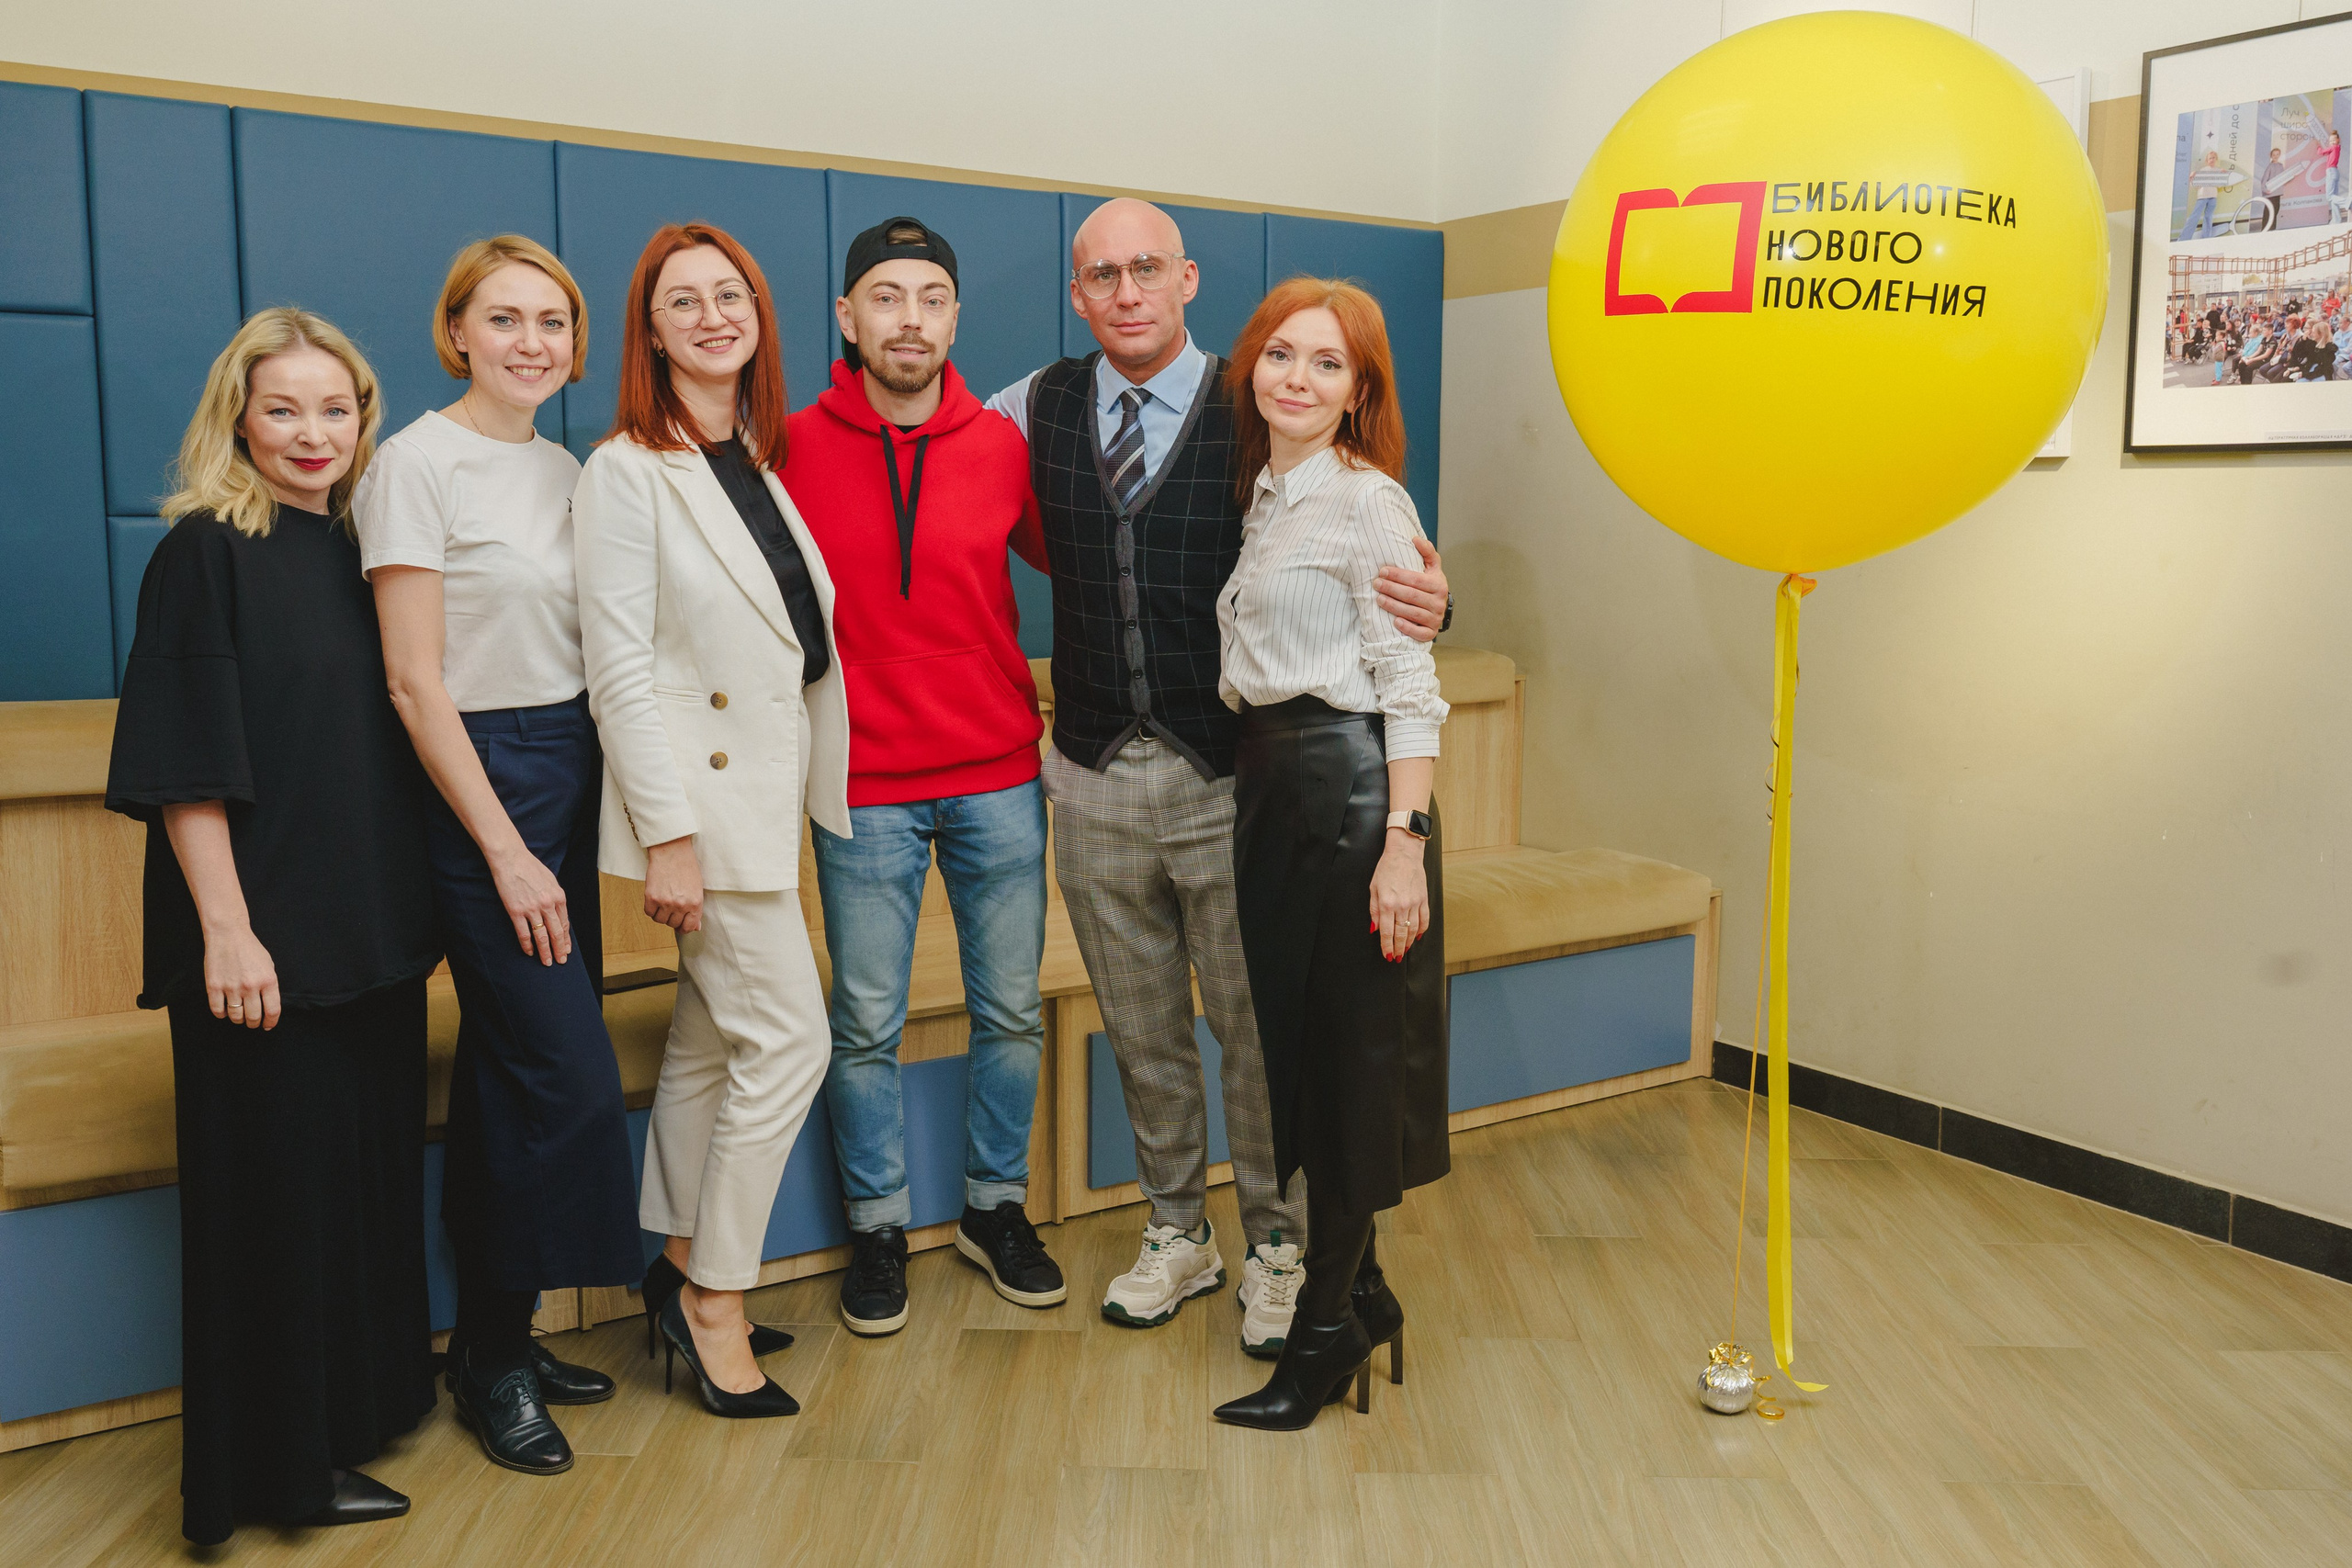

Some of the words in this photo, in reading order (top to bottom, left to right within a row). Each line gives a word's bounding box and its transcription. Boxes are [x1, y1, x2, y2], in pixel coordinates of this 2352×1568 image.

[2232, 114, 2240, 129] до
[2280, 107, 2300, 118] Луч
[2229, 132, 2238, 161] дней
[1772, 181, 2017, 230] БИБЛИОТЕКА
[1766, 229, 1923, 265] НОВОГО
[1762, 276, 1986, 318] ПОКОЛЕНИЯ
